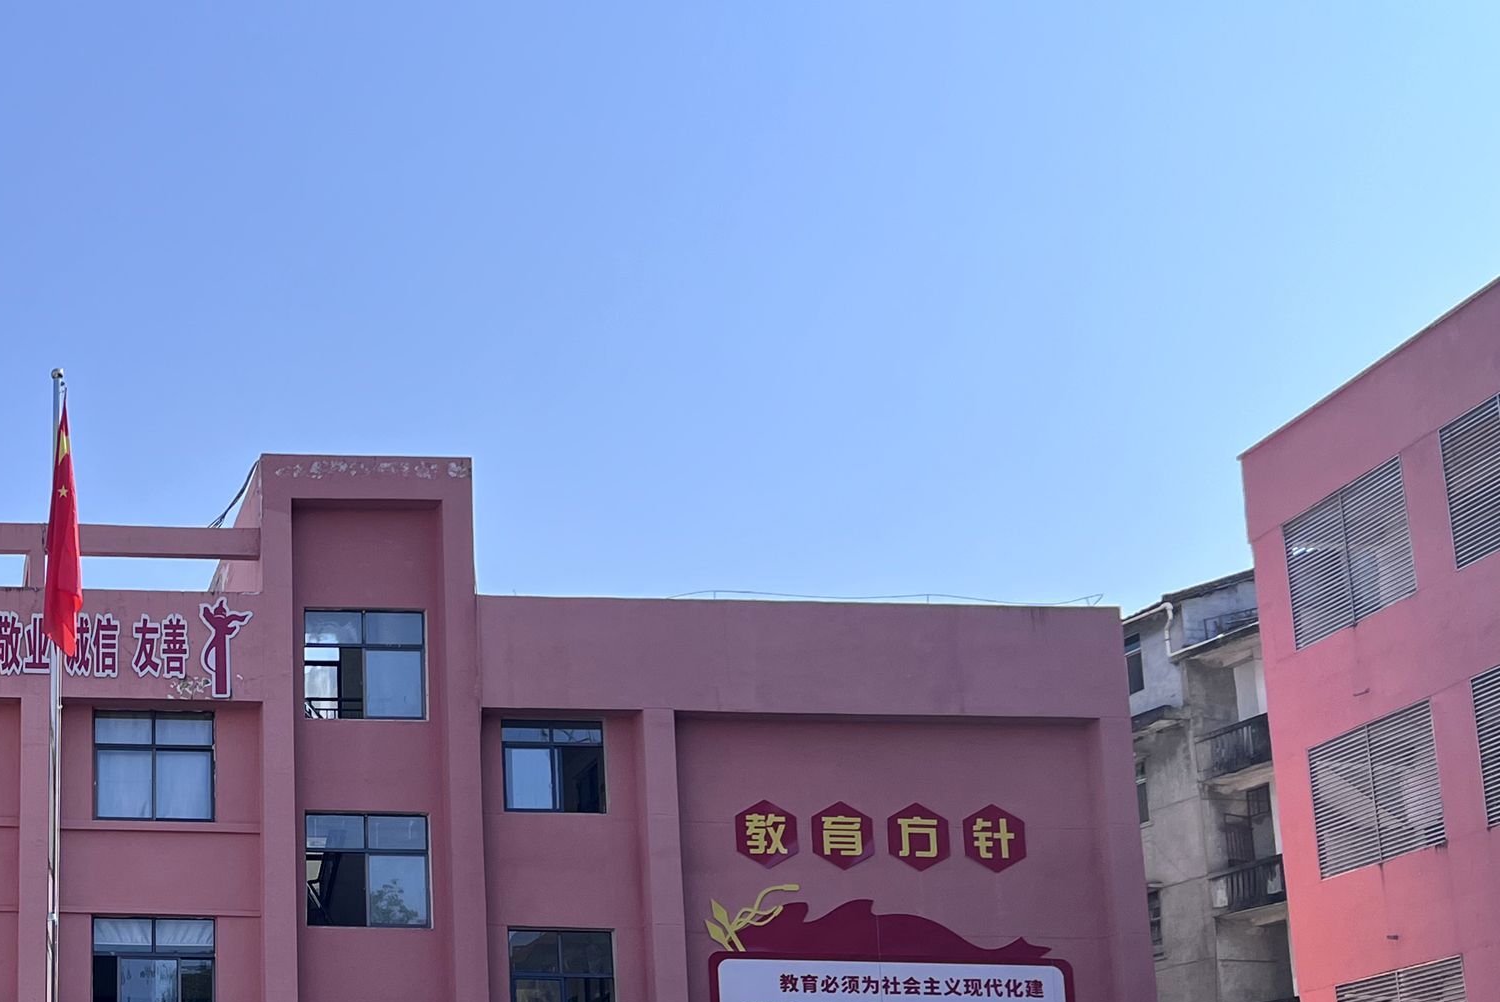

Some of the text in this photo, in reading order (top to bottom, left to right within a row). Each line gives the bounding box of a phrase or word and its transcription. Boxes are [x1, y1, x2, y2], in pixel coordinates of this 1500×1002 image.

[132, 618, 188, 674] 友善
[745, 813, 1015, 860] 教育方针
[779, 973, 1045, 999] 教育必须为社会主义现代化建
